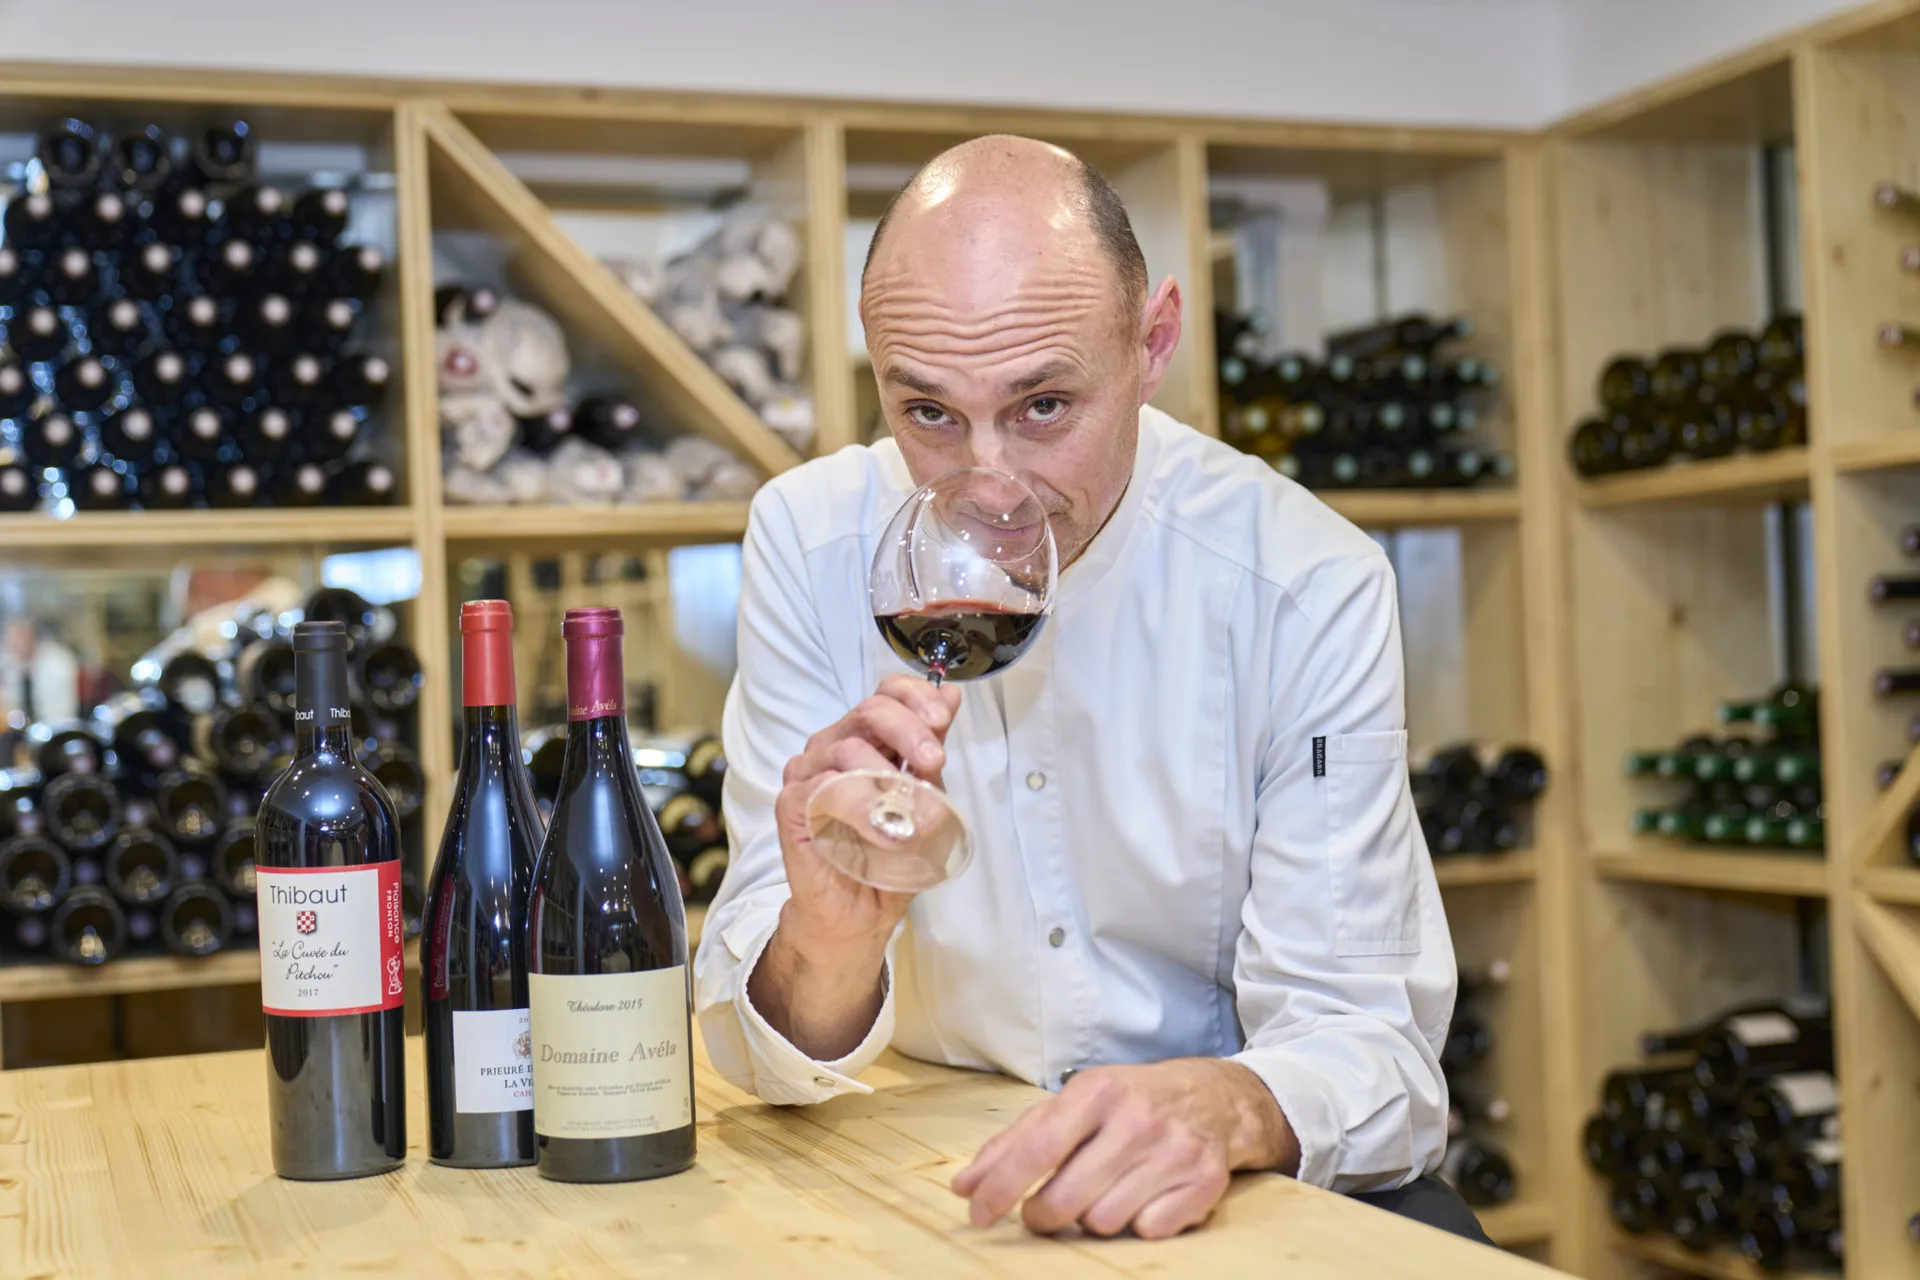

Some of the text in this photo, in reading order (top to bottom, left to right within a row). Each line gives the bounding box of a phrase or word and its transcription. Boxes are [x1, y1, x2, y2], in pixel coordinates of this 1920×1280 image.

[269, 884, 348, 904] Thibaut
[291, 940, 328, 960] Cuvée
[329, 941, 350, 957] du
[297, 988, 319, 997] 2017
[566, 998, 643, 1013] Théodore 2015
[541, 1040, 677, 1064] Domaine Avéla
[480, 1063, 523, 1076] PRIEURÉ
[504, 1079, 518, 1089] LA
